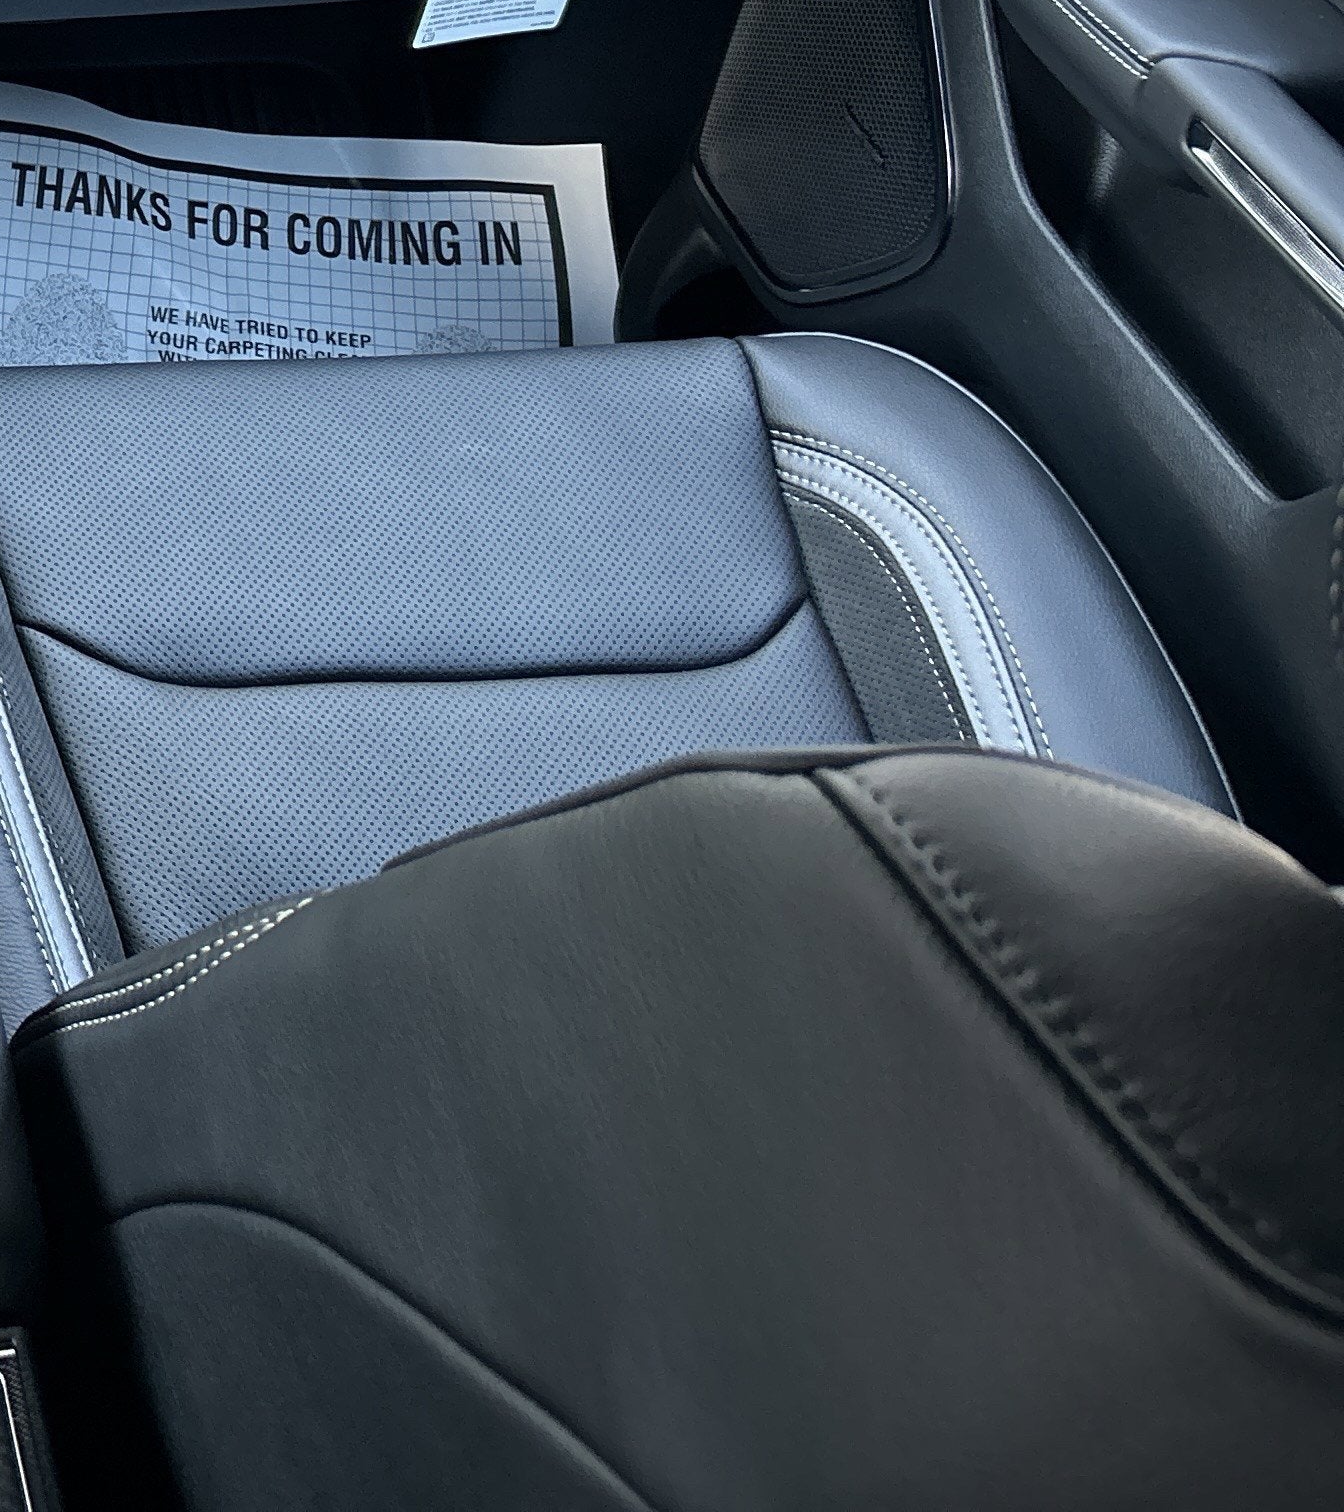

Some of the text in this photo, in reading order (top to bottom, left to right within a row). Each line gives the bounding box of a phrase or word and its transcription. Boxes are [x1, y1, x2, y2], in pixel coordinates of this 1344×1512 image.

[10, 162, 523, 267] THANKS FOR COMING IN
[147, 329, 308, 360] YOUR CARPETING
[150, 306, 372, 349] WE HAVE TRIED TO KEEP
[158, 349, 197, 363] WIT
